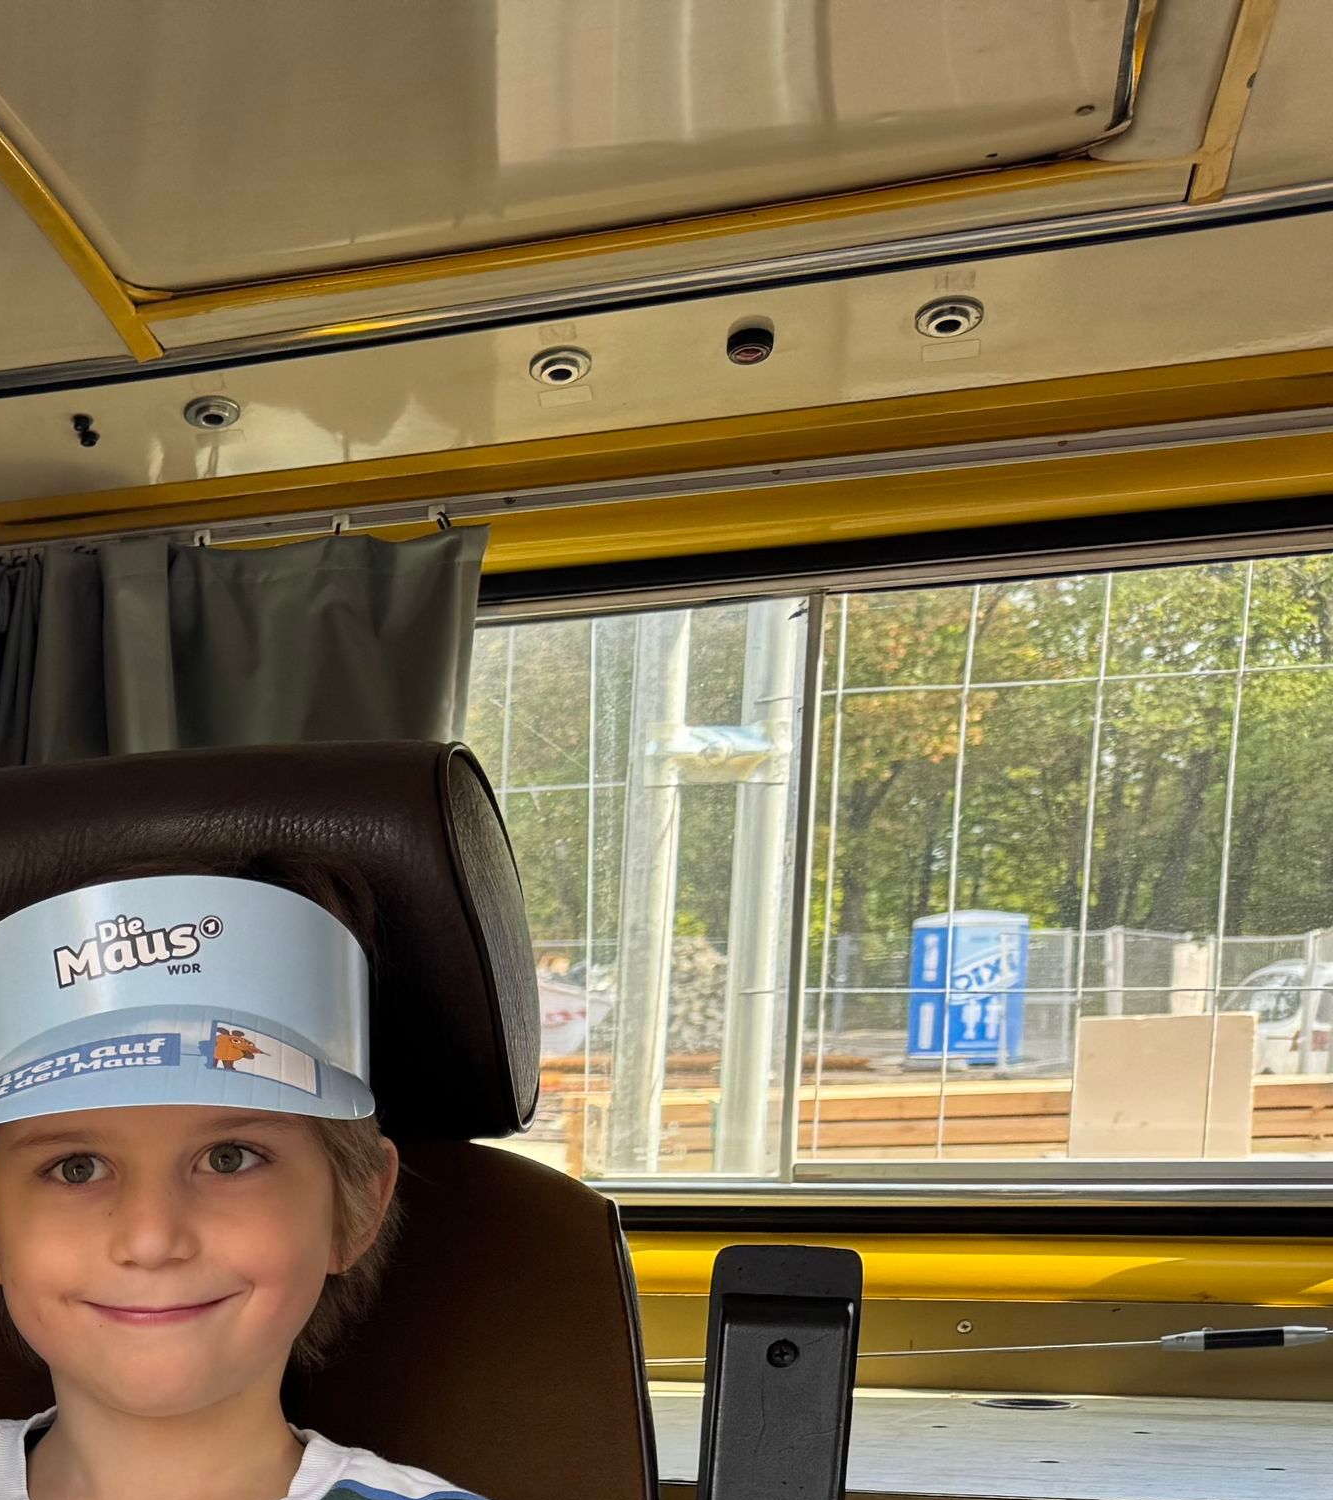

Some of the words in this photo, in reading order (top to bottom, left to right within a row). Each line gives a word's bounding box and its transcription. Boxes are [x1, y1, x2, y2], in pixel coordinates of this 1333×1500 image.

[97, 915, 144, 943] Die
[54, 924, 199, 988] Maus
[167, 963, 201, 976] WDR
[90, 1038, 166, 1059] auf
[14, 1067, 67, 1090] der
[73, 1055, 162, 1074] Maus
